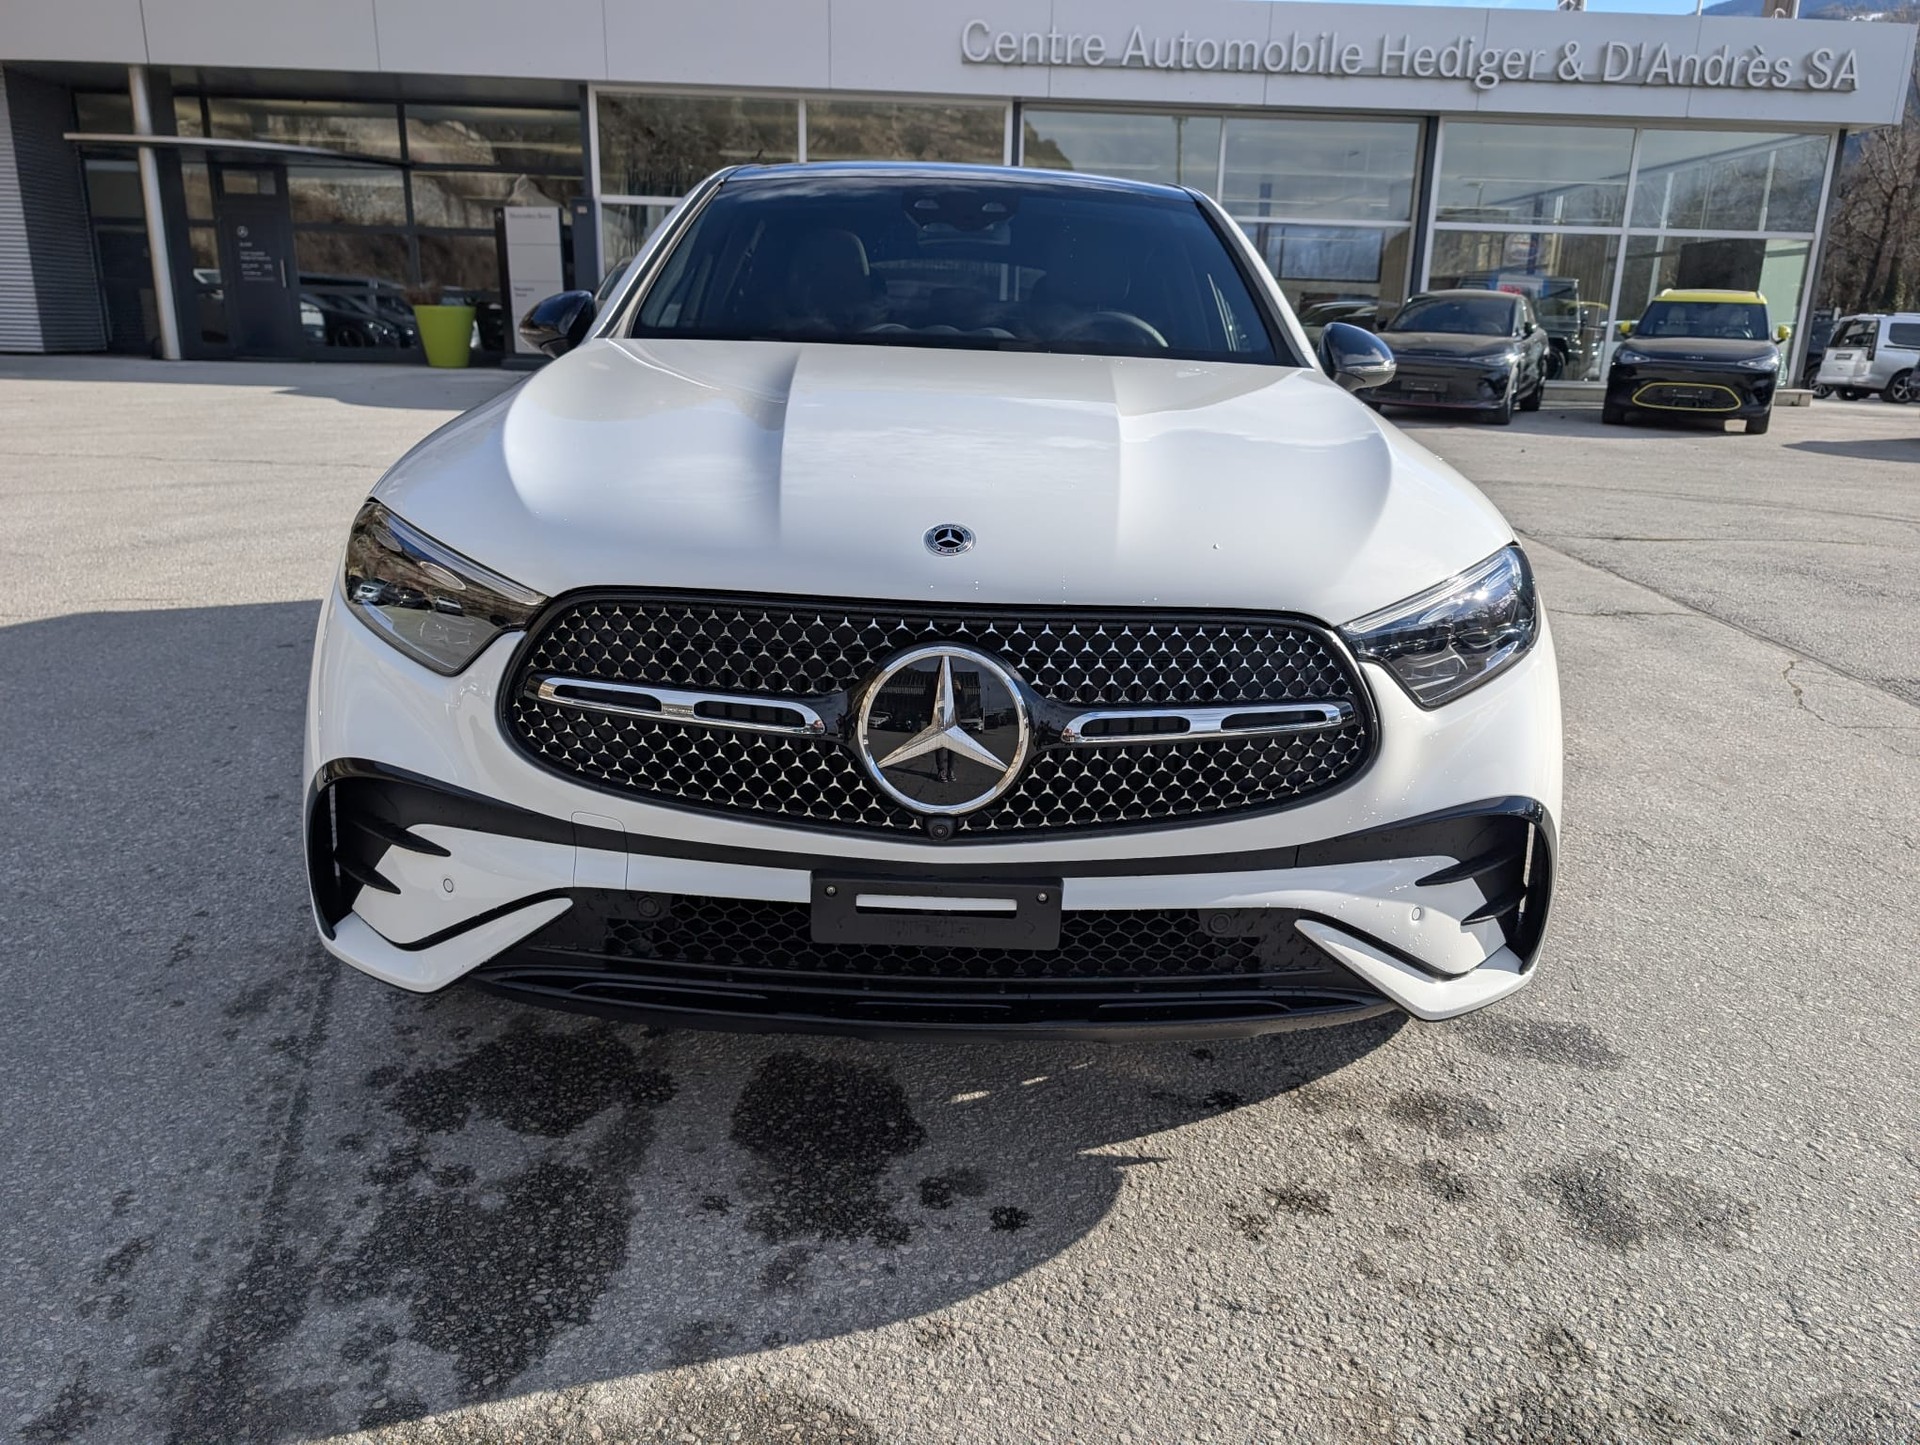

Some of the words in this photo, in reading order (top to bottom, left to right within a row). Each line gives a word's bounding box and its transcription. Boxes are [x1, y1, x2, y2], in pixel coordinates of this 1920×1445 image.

[962, 19, 1106, 65] Centre
[1122, 24, 1363, 74] Automobile
[1380, 33, 1546, 89] Hediger
[1557, 40, 1584, 81] &
[1603, 40, 1792, 87] D'Andrès
[1807, 47, 1859, 90] SA
